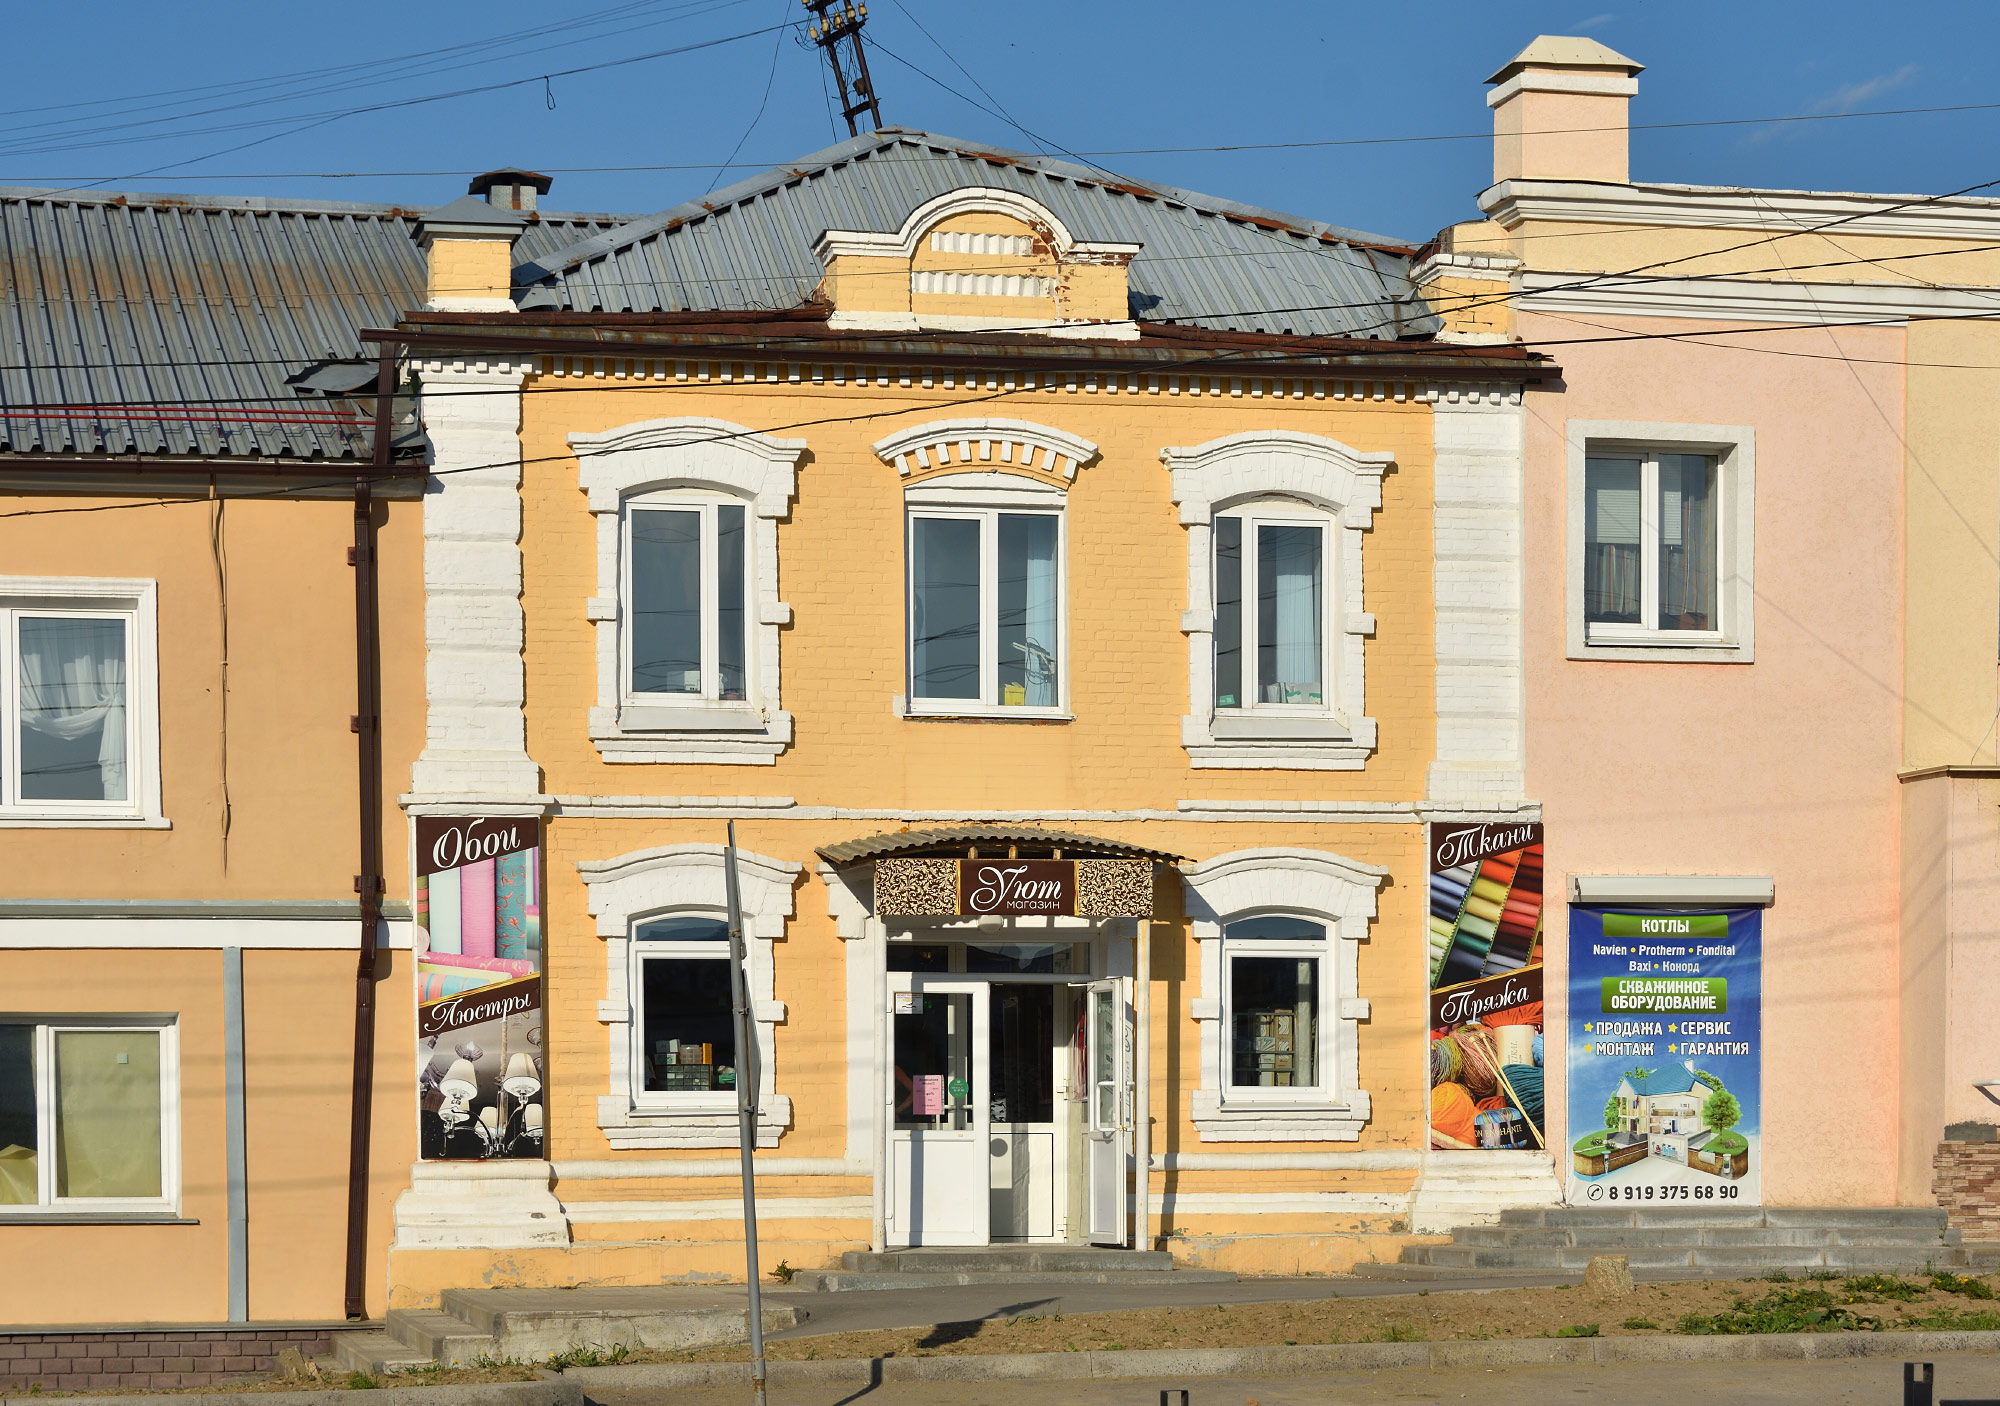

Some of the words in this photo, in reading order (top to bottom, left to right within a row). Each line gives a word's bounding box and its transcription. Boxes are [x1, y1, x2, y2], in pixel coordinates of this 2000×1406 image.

[433, 817, 520, 869] Обои
[1437, 824, 1533, 867] Ткани
[970, 866, 1061, 911] Уют
[1007, 900, 1060, 910] магазин
[1642, 920, 1689, 933] КОТЛЫ
[1594, 944, 1627, 956] Navien
[1639, 944, 1685, 956] Protherm
[1697, 944, 1735, 956] Fondital
[1629, 961, 1650, 972] Baxi
[1663, 962, 1699, 973] Конорд
[1619, 980, 1708, 994] СКВАЖИННОЕ
[1440, 979, 1529, 1024] Пряжа
[1612, 996, 1716, 1011] ОБОРУДОВАНИЕ
[424, 992, 531, 1032] Люстры
[1596, 1022, 1662, 1037] ПРОДАЖА
[1681, 1022, 1731, 1035] СЕРВИС
[1596, 1042, 1654, 1056] МОНТАЖ
[1681, 1042, 1749, 1056] ГАРАНТИЯ
[1609, 1187, 1618, 1200] 8
[1624, 1187, 1654, 1200] 919
[1660, 1186, 1688, 1200] 375
[1695, 1186, 1714, 1199] 68
[1720, 1186, 1738, 1198] 90
